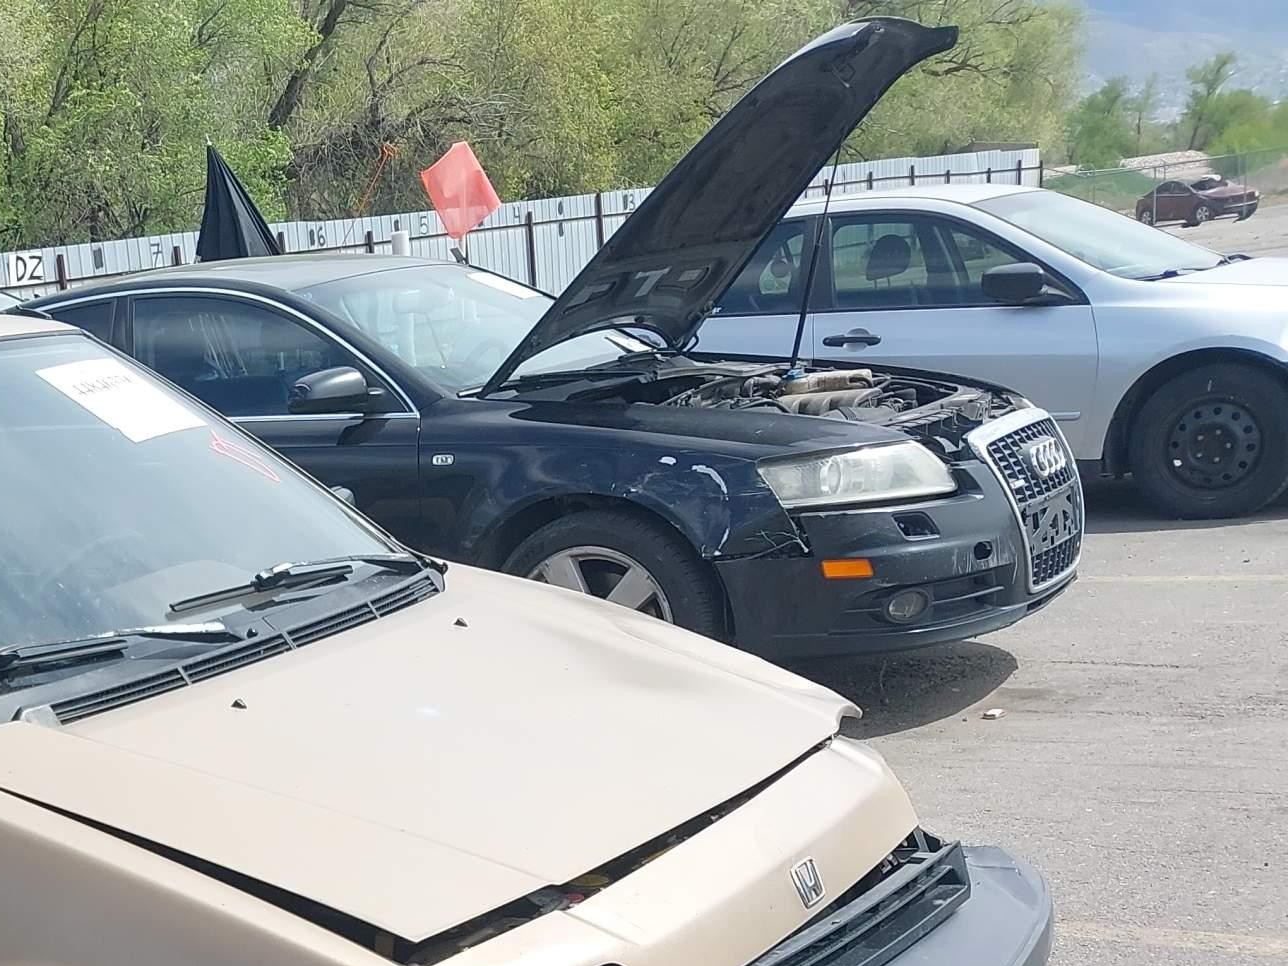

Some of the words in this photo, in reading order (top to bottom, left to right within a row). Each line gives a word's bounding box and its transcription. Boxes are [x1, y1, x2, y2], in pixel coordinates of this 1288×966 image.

[419, 215, 430, 236] 5
[512, 206, 521, 225] 4
[150, 242, 163, 269] 7
[15, 255, 44, 282] DZ
